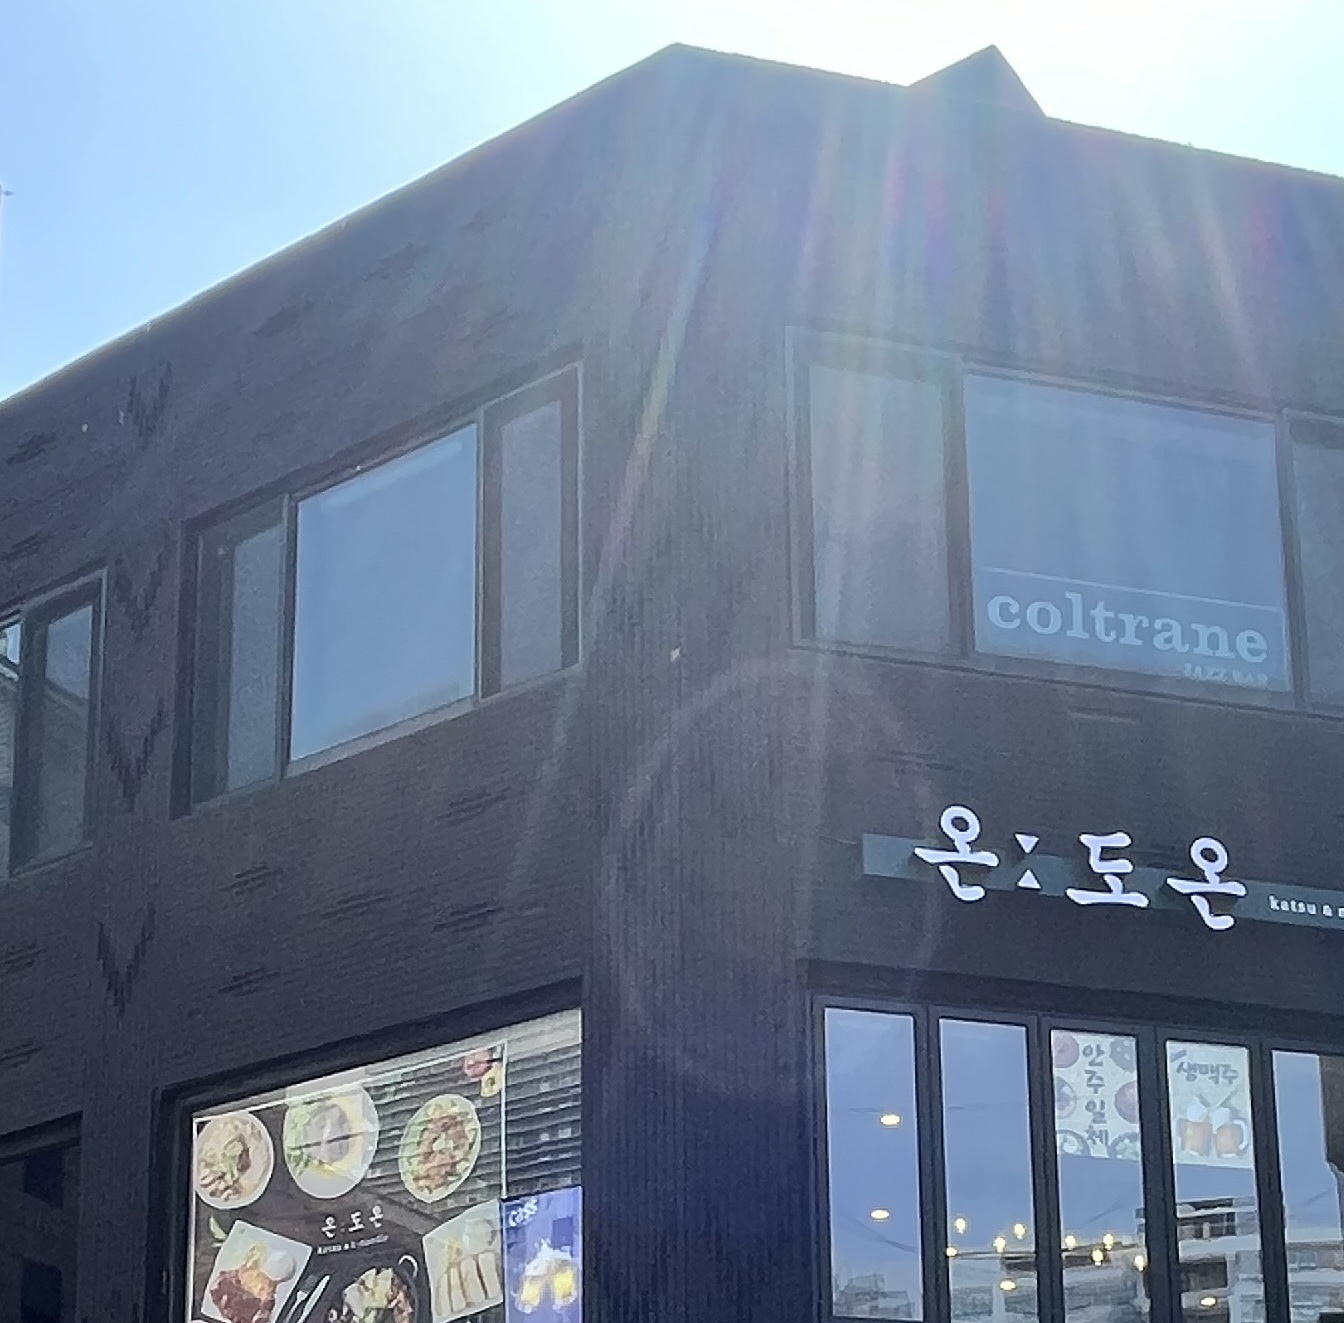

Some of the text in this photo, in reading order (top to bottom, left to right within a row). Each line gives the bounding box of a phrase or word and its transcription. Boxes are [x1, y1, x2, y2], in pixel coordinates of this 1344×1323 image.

[985, 590, 1270, 663] coltrane
[1267, 894, 1318, 918] katsu
[1175, 1061, 1240, 1085] 생맥주
